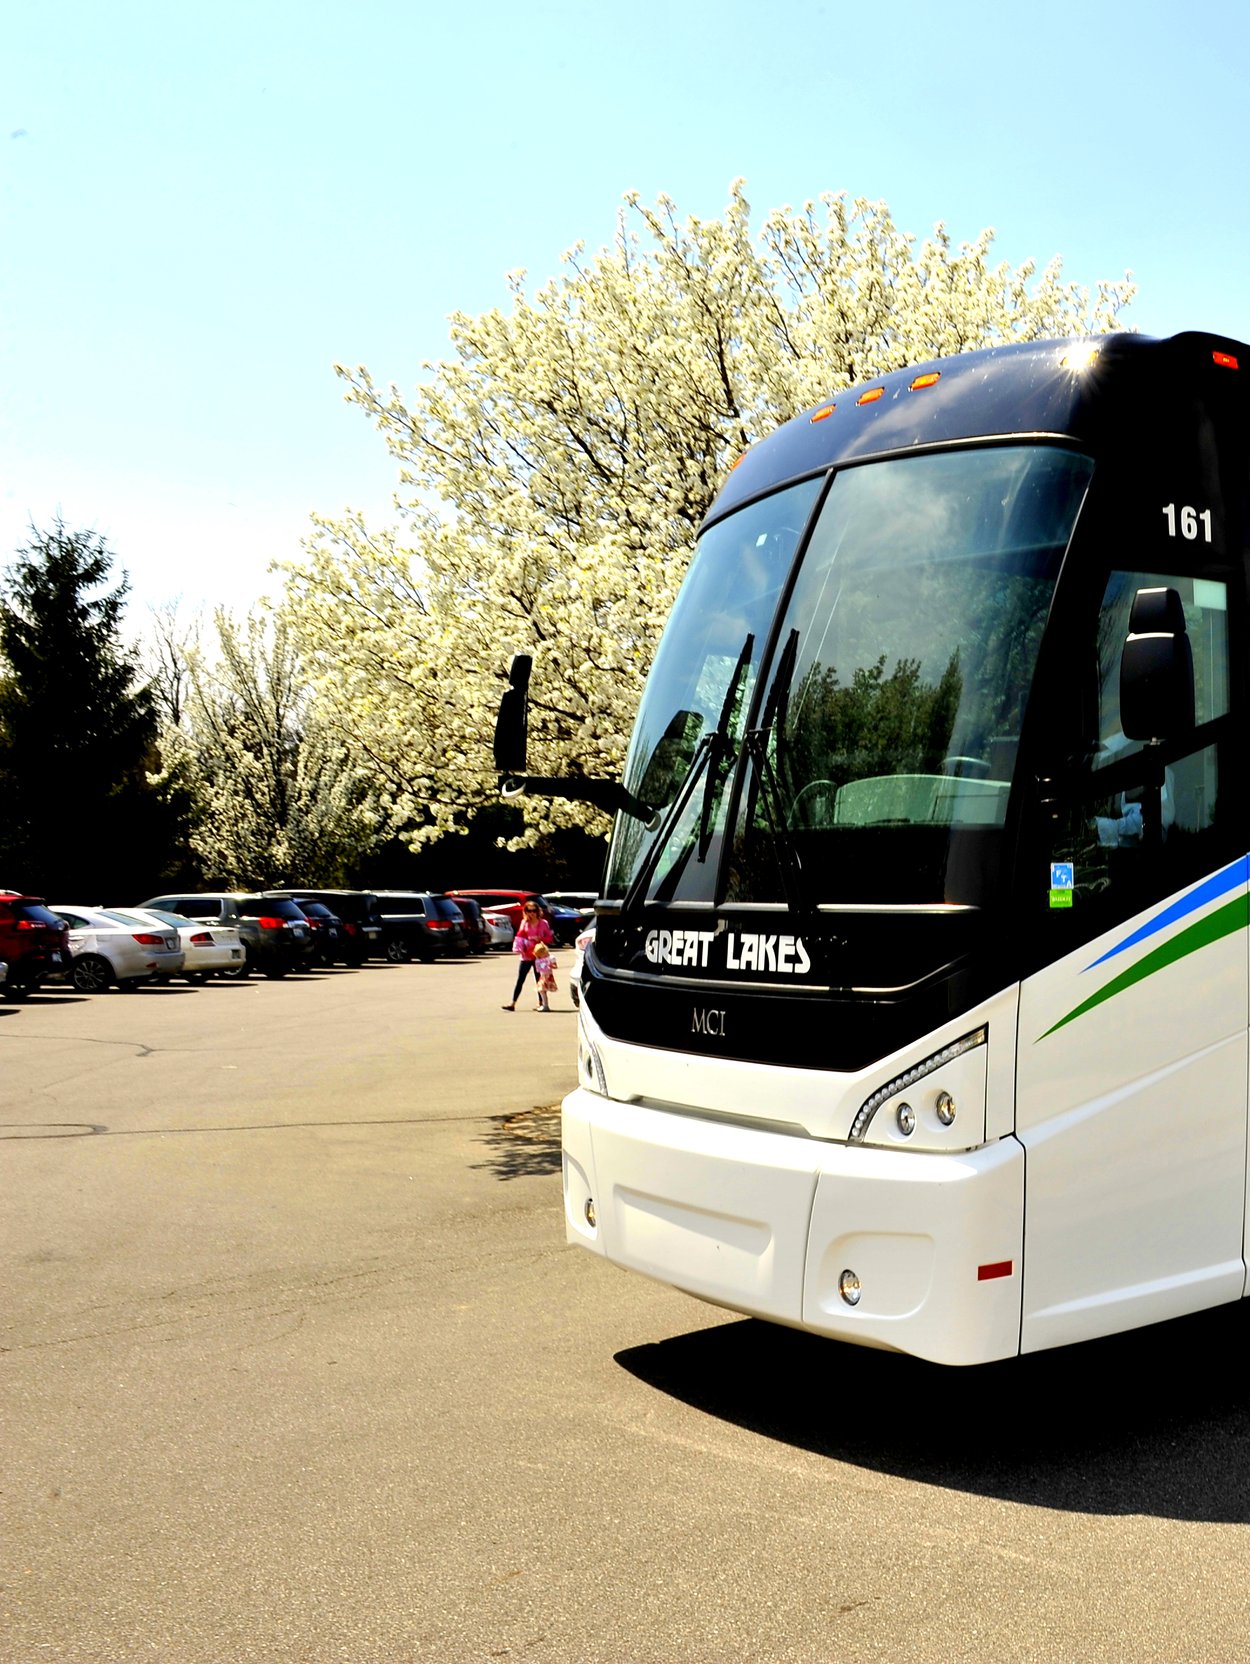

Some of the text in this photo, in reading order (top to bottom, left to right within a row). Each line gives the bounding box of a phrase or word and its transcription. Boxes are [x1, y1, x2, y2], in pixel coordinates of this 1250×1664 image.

[1162, 502, 1212, 543] 161
[645, 930, 811, 974] GREAT LAKES
[691, 1007, 726, 1036] MCI
